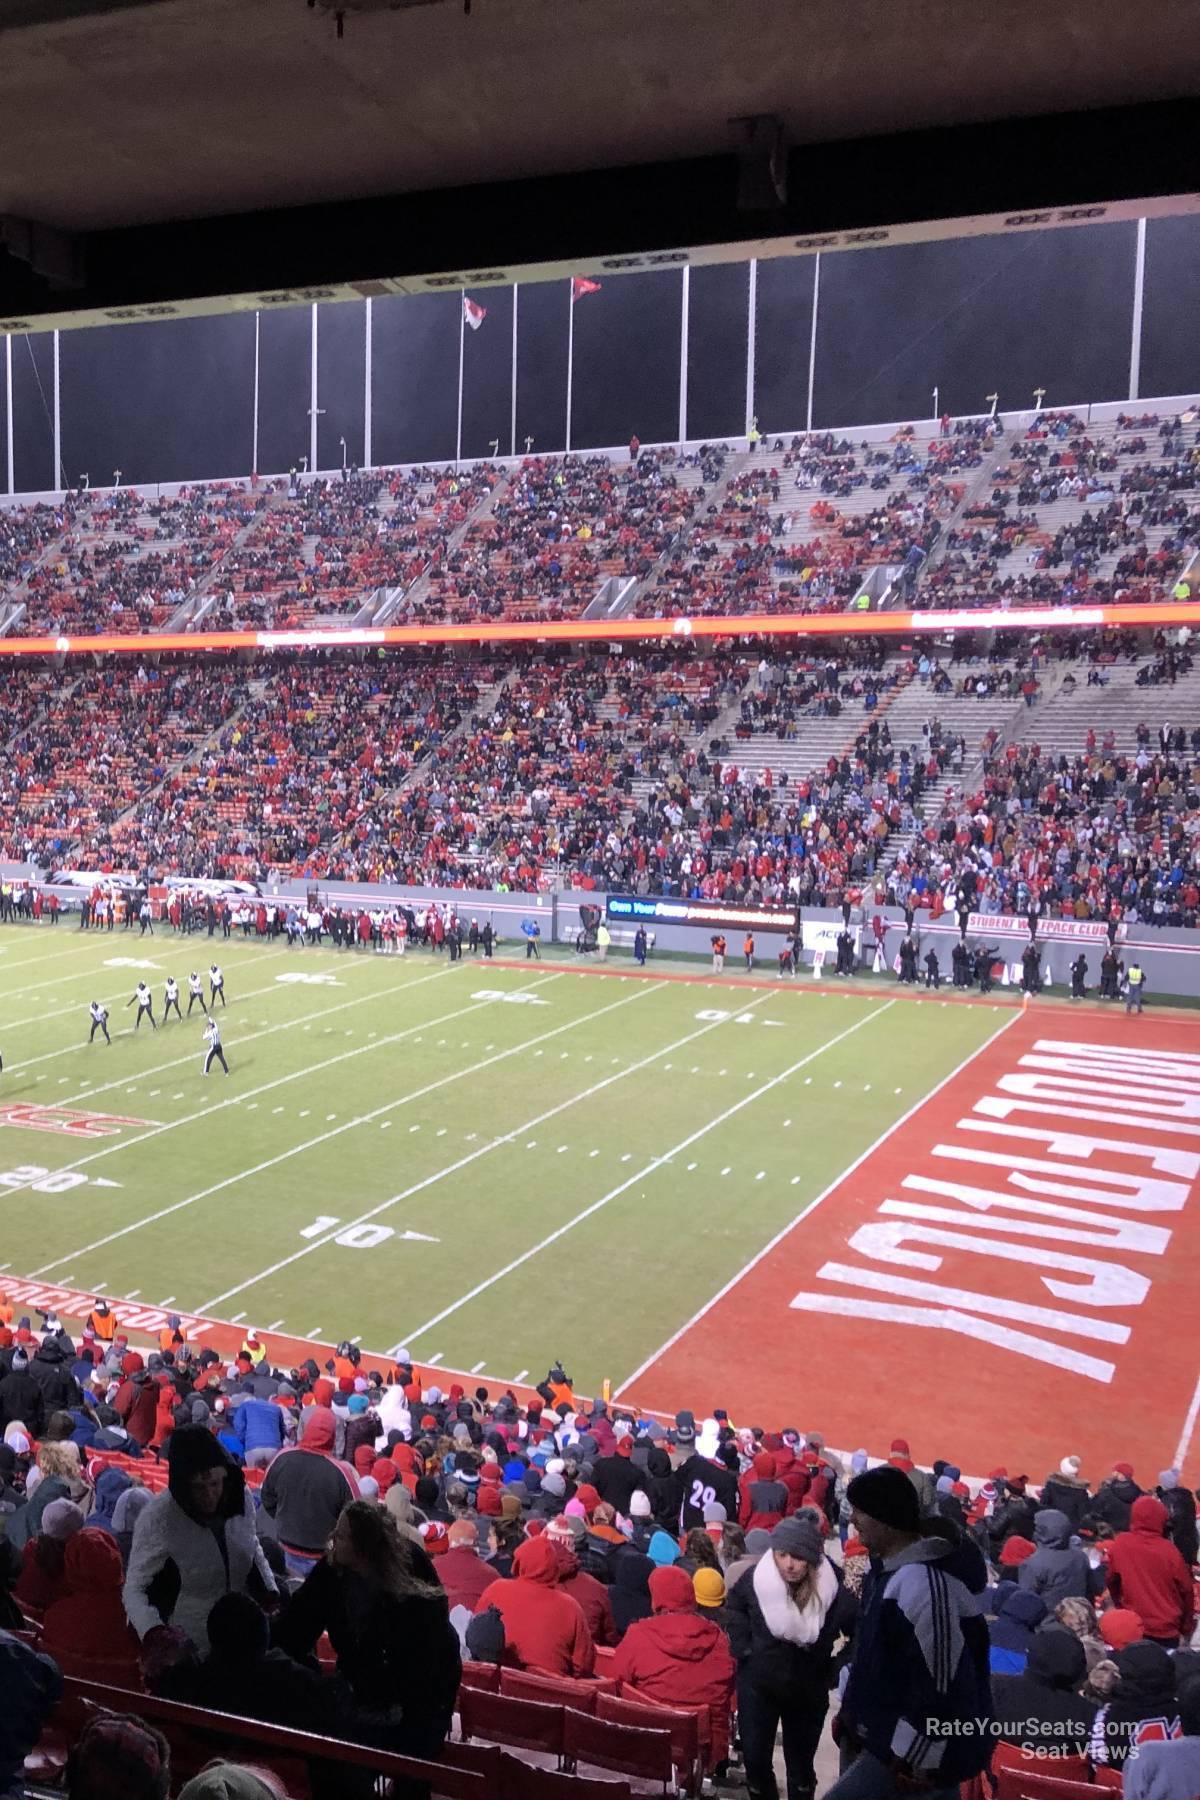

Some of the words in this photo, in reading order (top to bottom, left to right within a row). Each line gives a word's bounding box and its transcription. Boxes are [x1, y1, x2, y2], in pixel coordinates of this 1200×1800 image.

[970, 915, 1014, 929] STUDENT
[1018, 918, 1075, 932] WFPACK
[1078, 924, 1107, 936] CLUB
[789, 1040, 1200, 1384] WOLFPACK
[299, 1215, 396, 1249] 10
